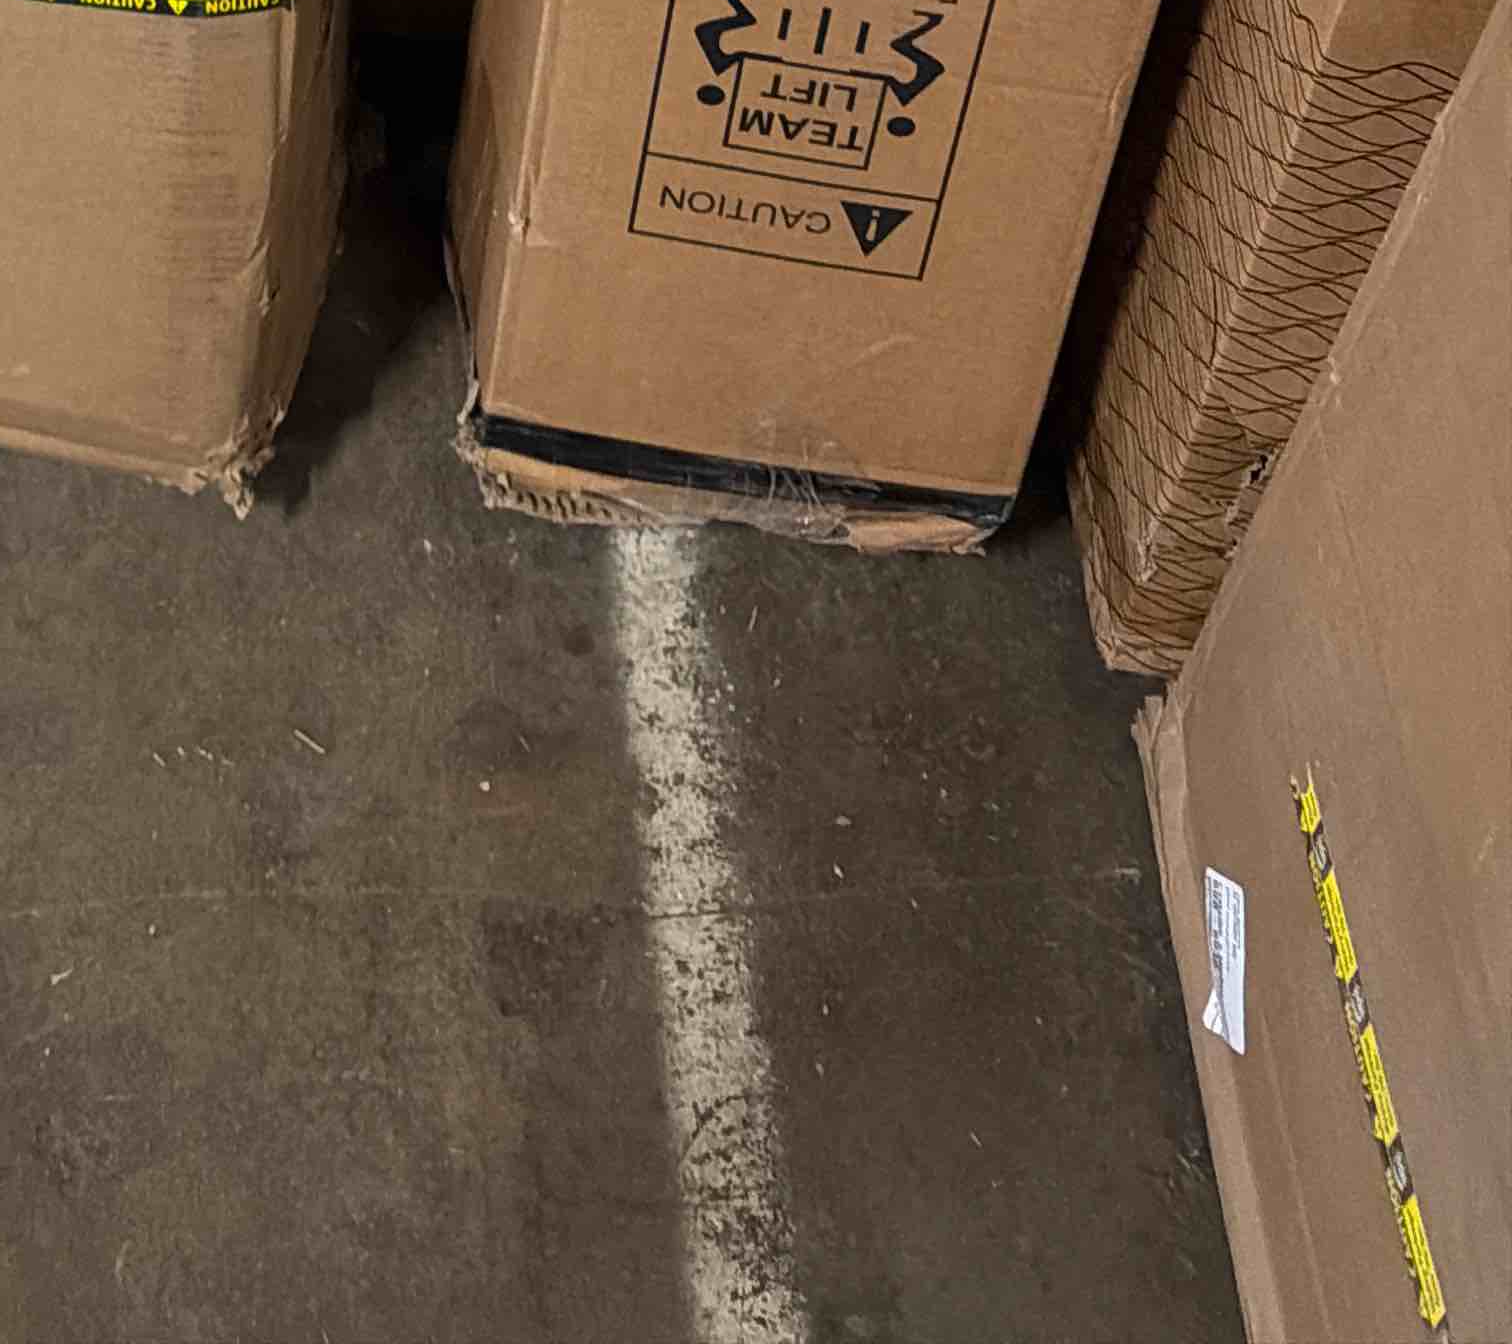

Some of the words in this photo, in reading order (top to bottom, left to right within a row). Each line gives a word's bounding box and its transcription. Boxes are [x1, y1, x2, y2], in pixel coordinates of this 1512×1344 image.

[760, 73, 858, 111] LIFT
[736, 106, 863, 152] TEAM
[660, 184, 831, 235] CAUTION
